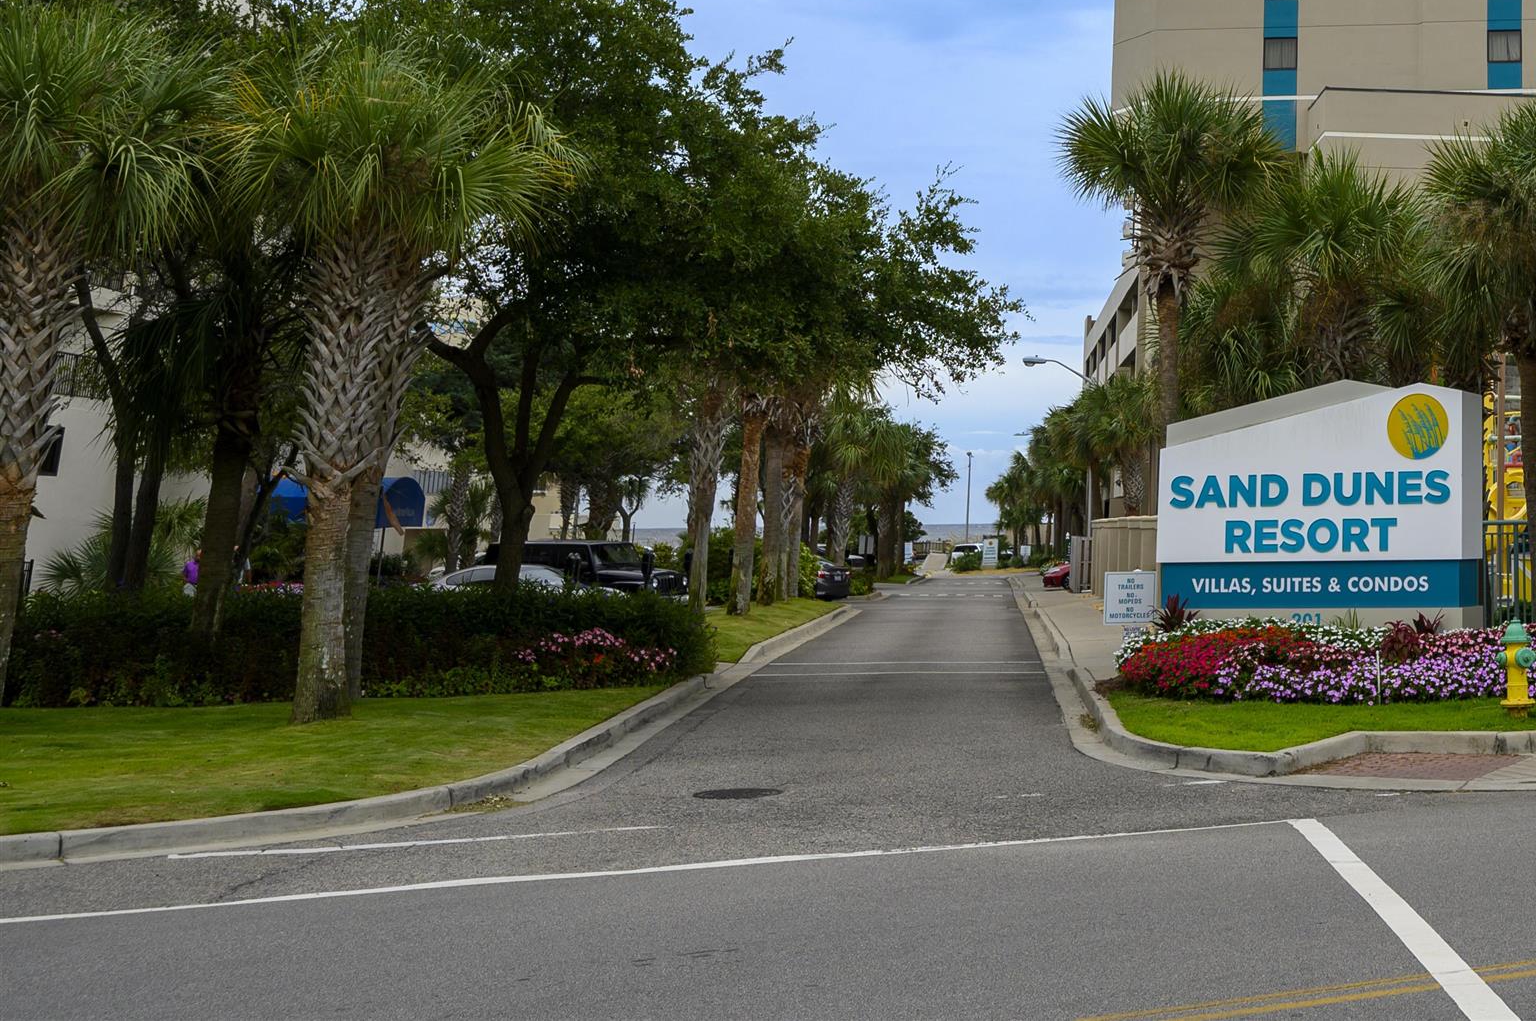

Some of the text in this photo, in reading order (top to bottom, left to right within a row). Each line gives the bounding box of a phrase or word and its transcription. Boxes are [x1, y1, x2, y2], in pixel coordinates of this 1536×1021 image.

[1169, 469, 1451, 509] SAND DUNES
[1224, 517, 1398, 554] RESORT
[1191, 575, 1429, 596] VILLAS, SUITES & CONDOS
